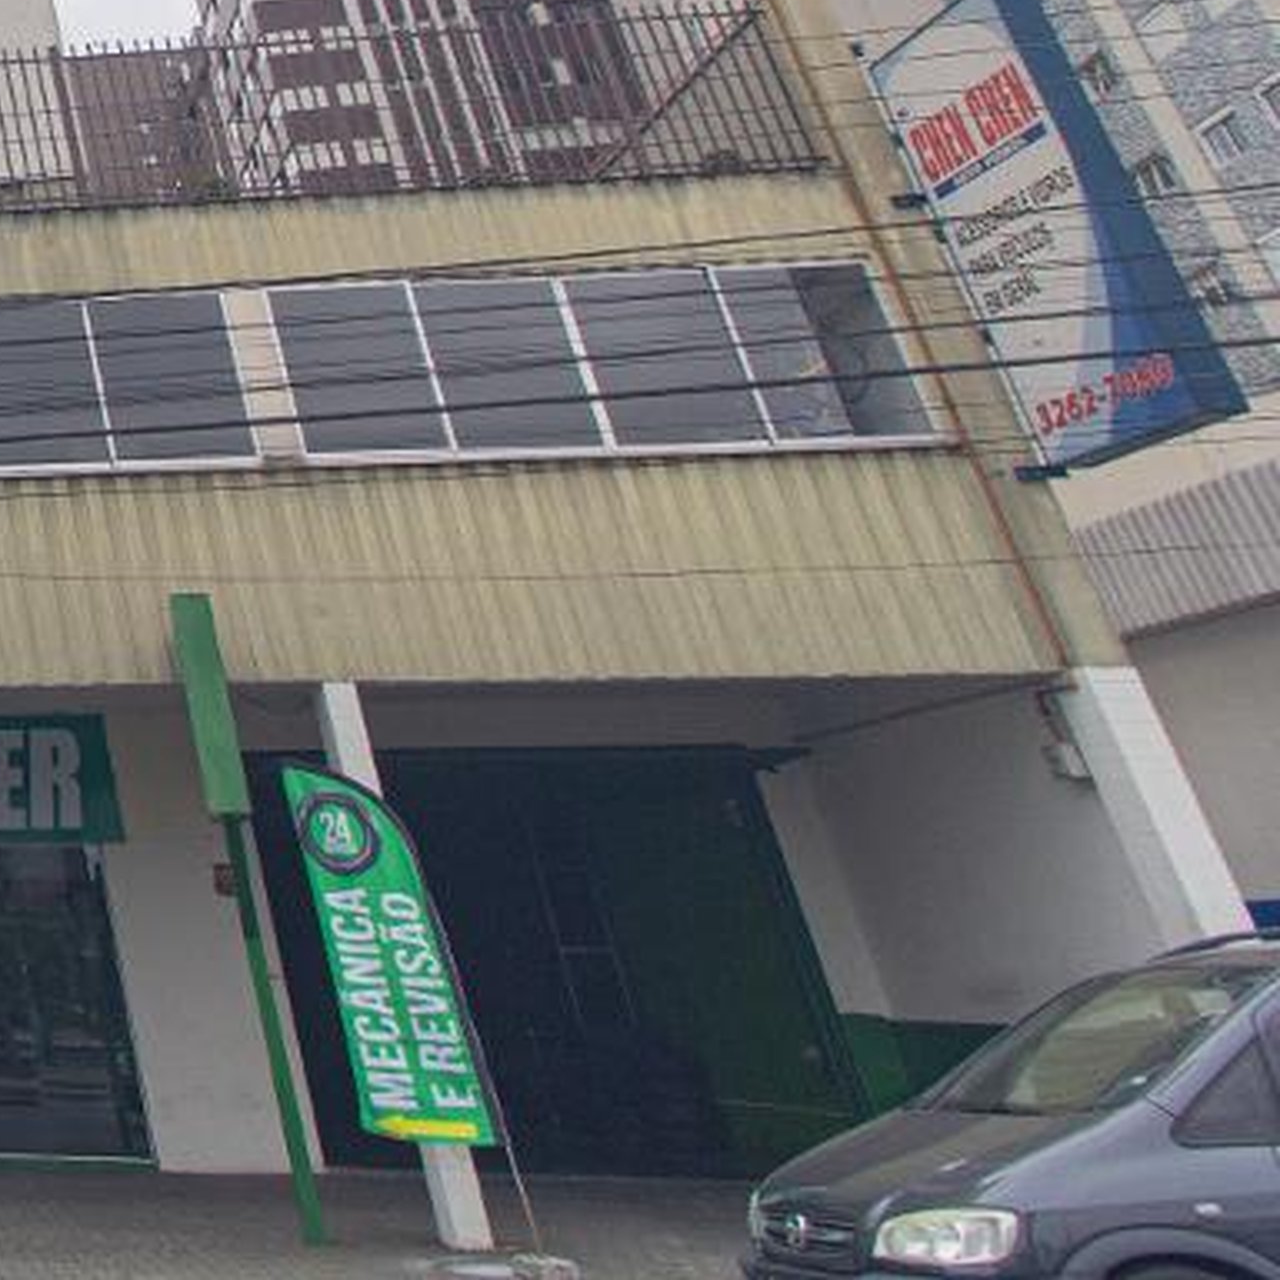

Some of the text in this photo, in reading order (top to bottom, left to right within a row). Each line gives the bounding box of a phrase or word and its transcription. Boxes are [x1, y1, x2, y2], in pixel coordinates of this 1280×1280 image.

[325, 887, 419, 1111] MECÂNICA
[381, 892, 479, 1110] E REVISÃO
